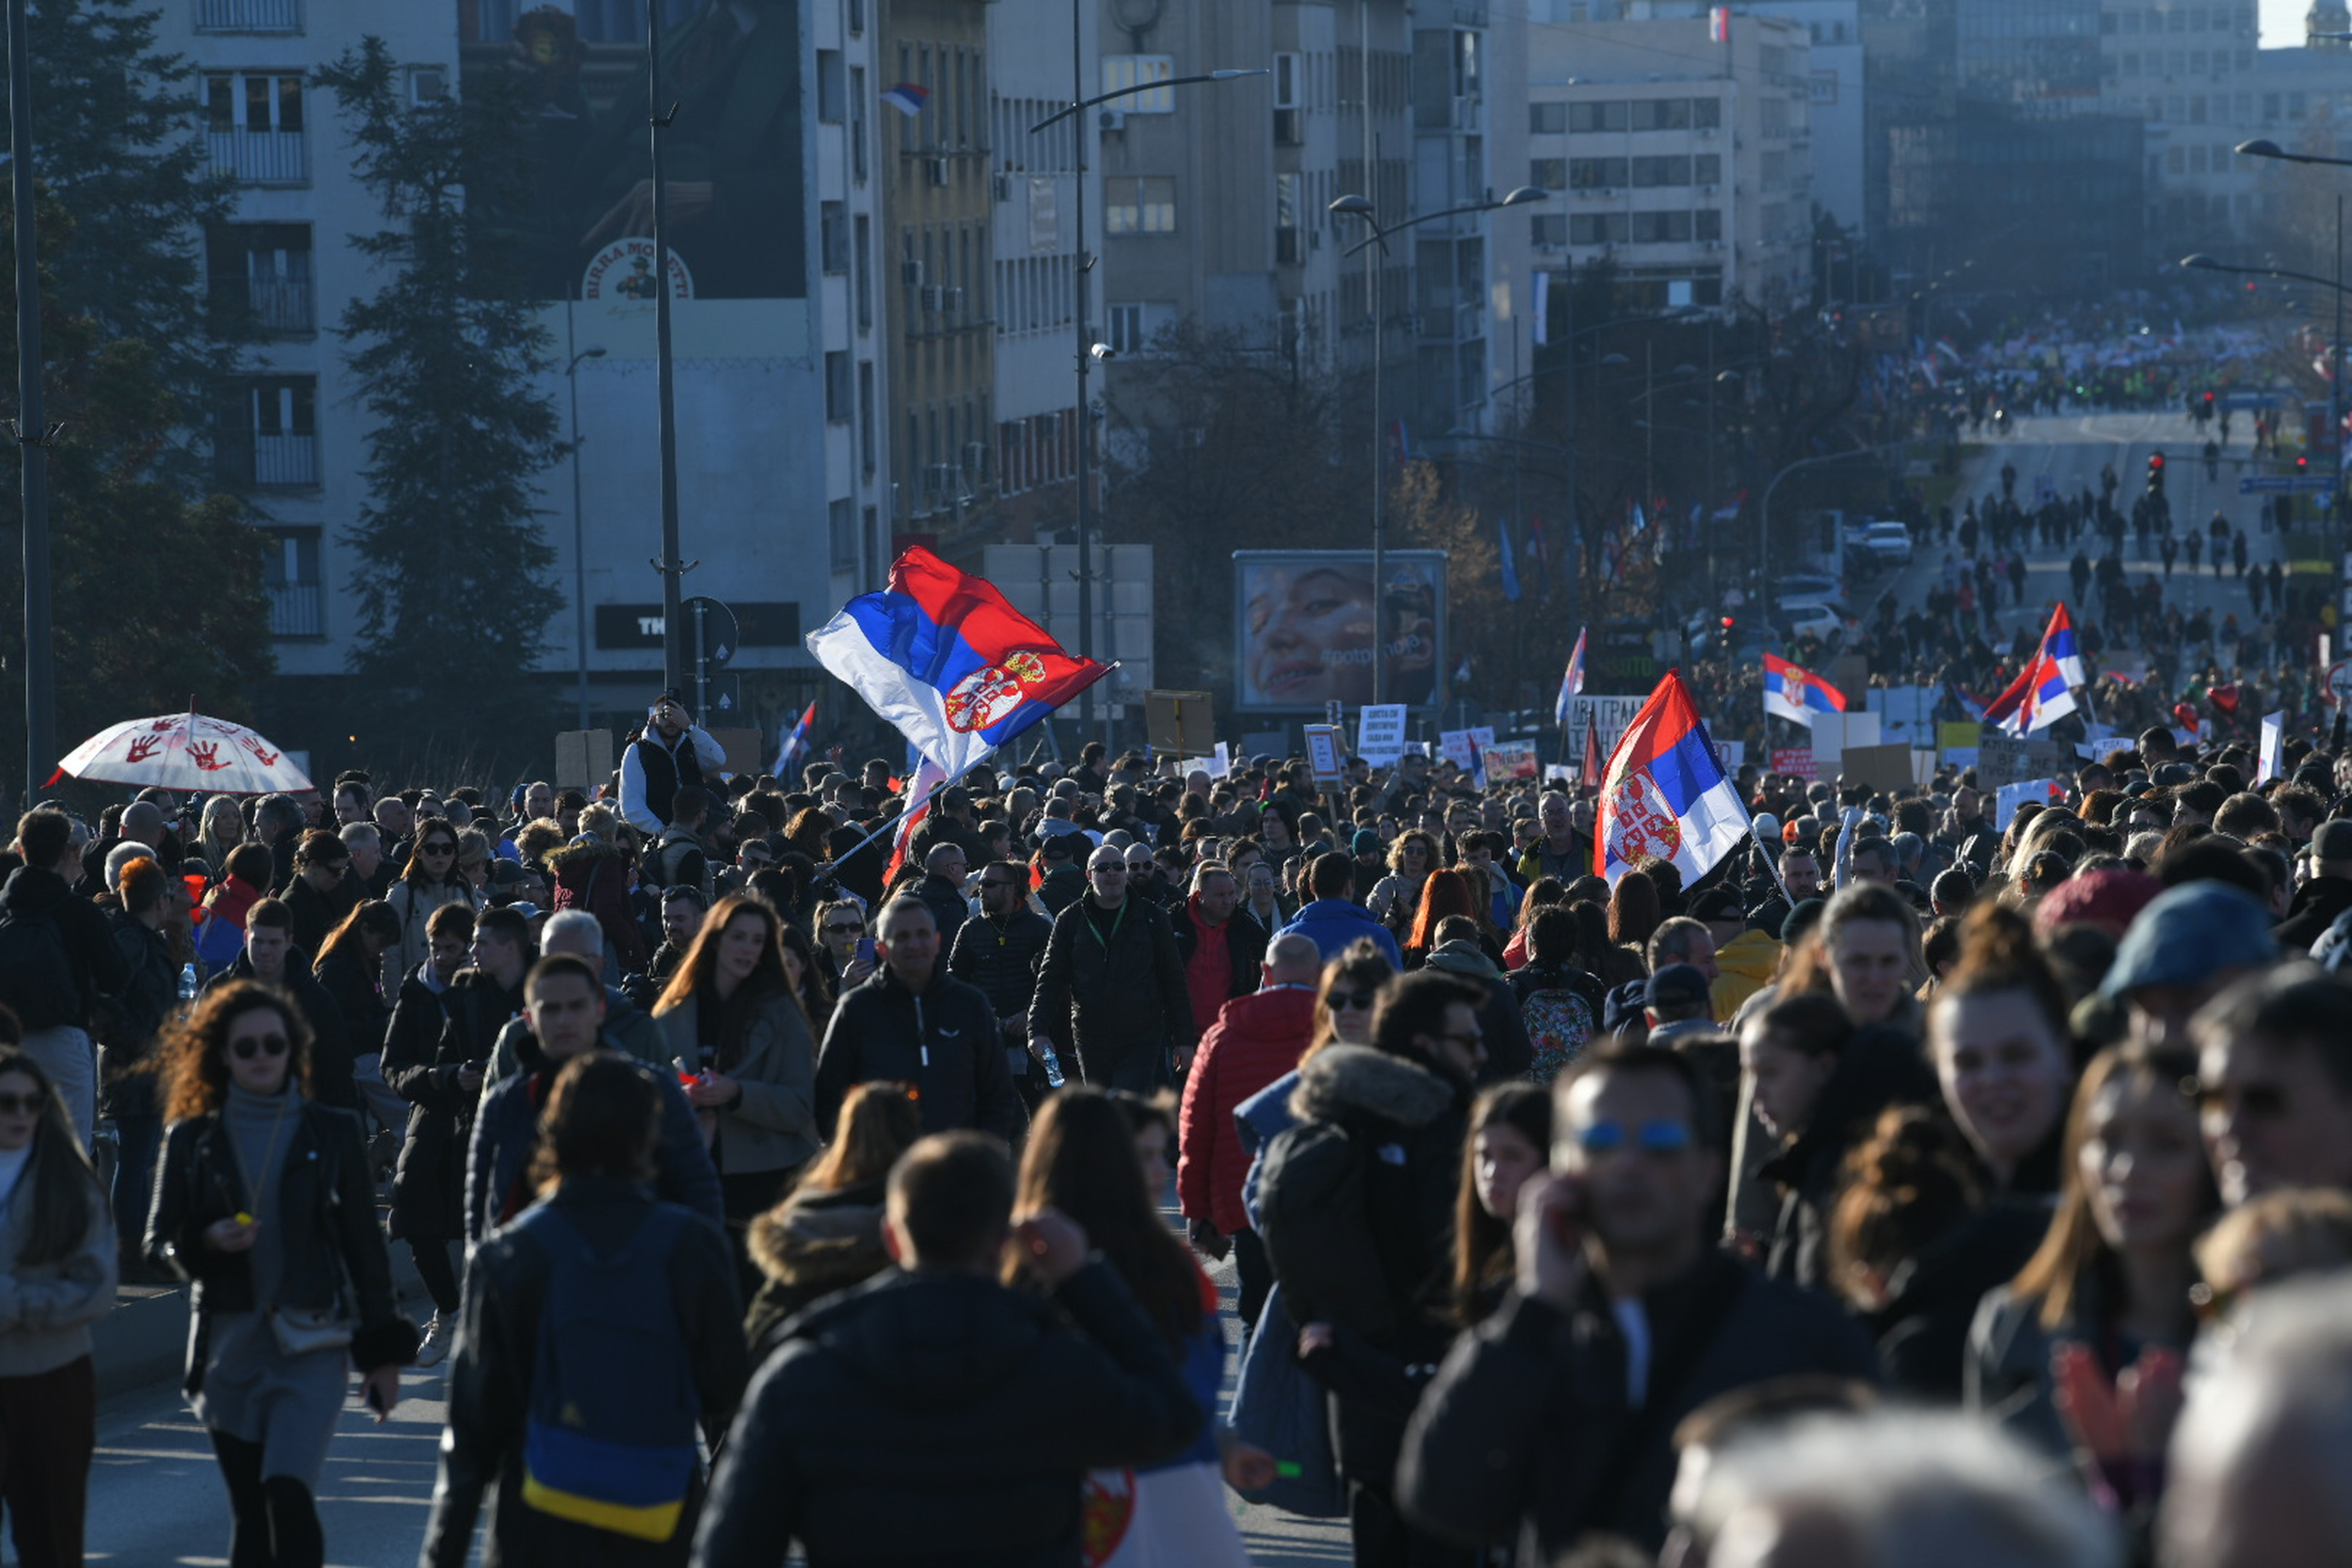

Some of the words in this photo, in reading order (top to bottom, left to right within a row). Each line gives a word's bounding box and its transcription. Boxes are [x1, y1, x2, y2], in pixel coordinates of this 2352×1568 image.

[587, 246, 624, 299] BIRRA
[627, 243, 689, 299] MOETTI
[1320, 633, 1420, 667] #potpnoja
